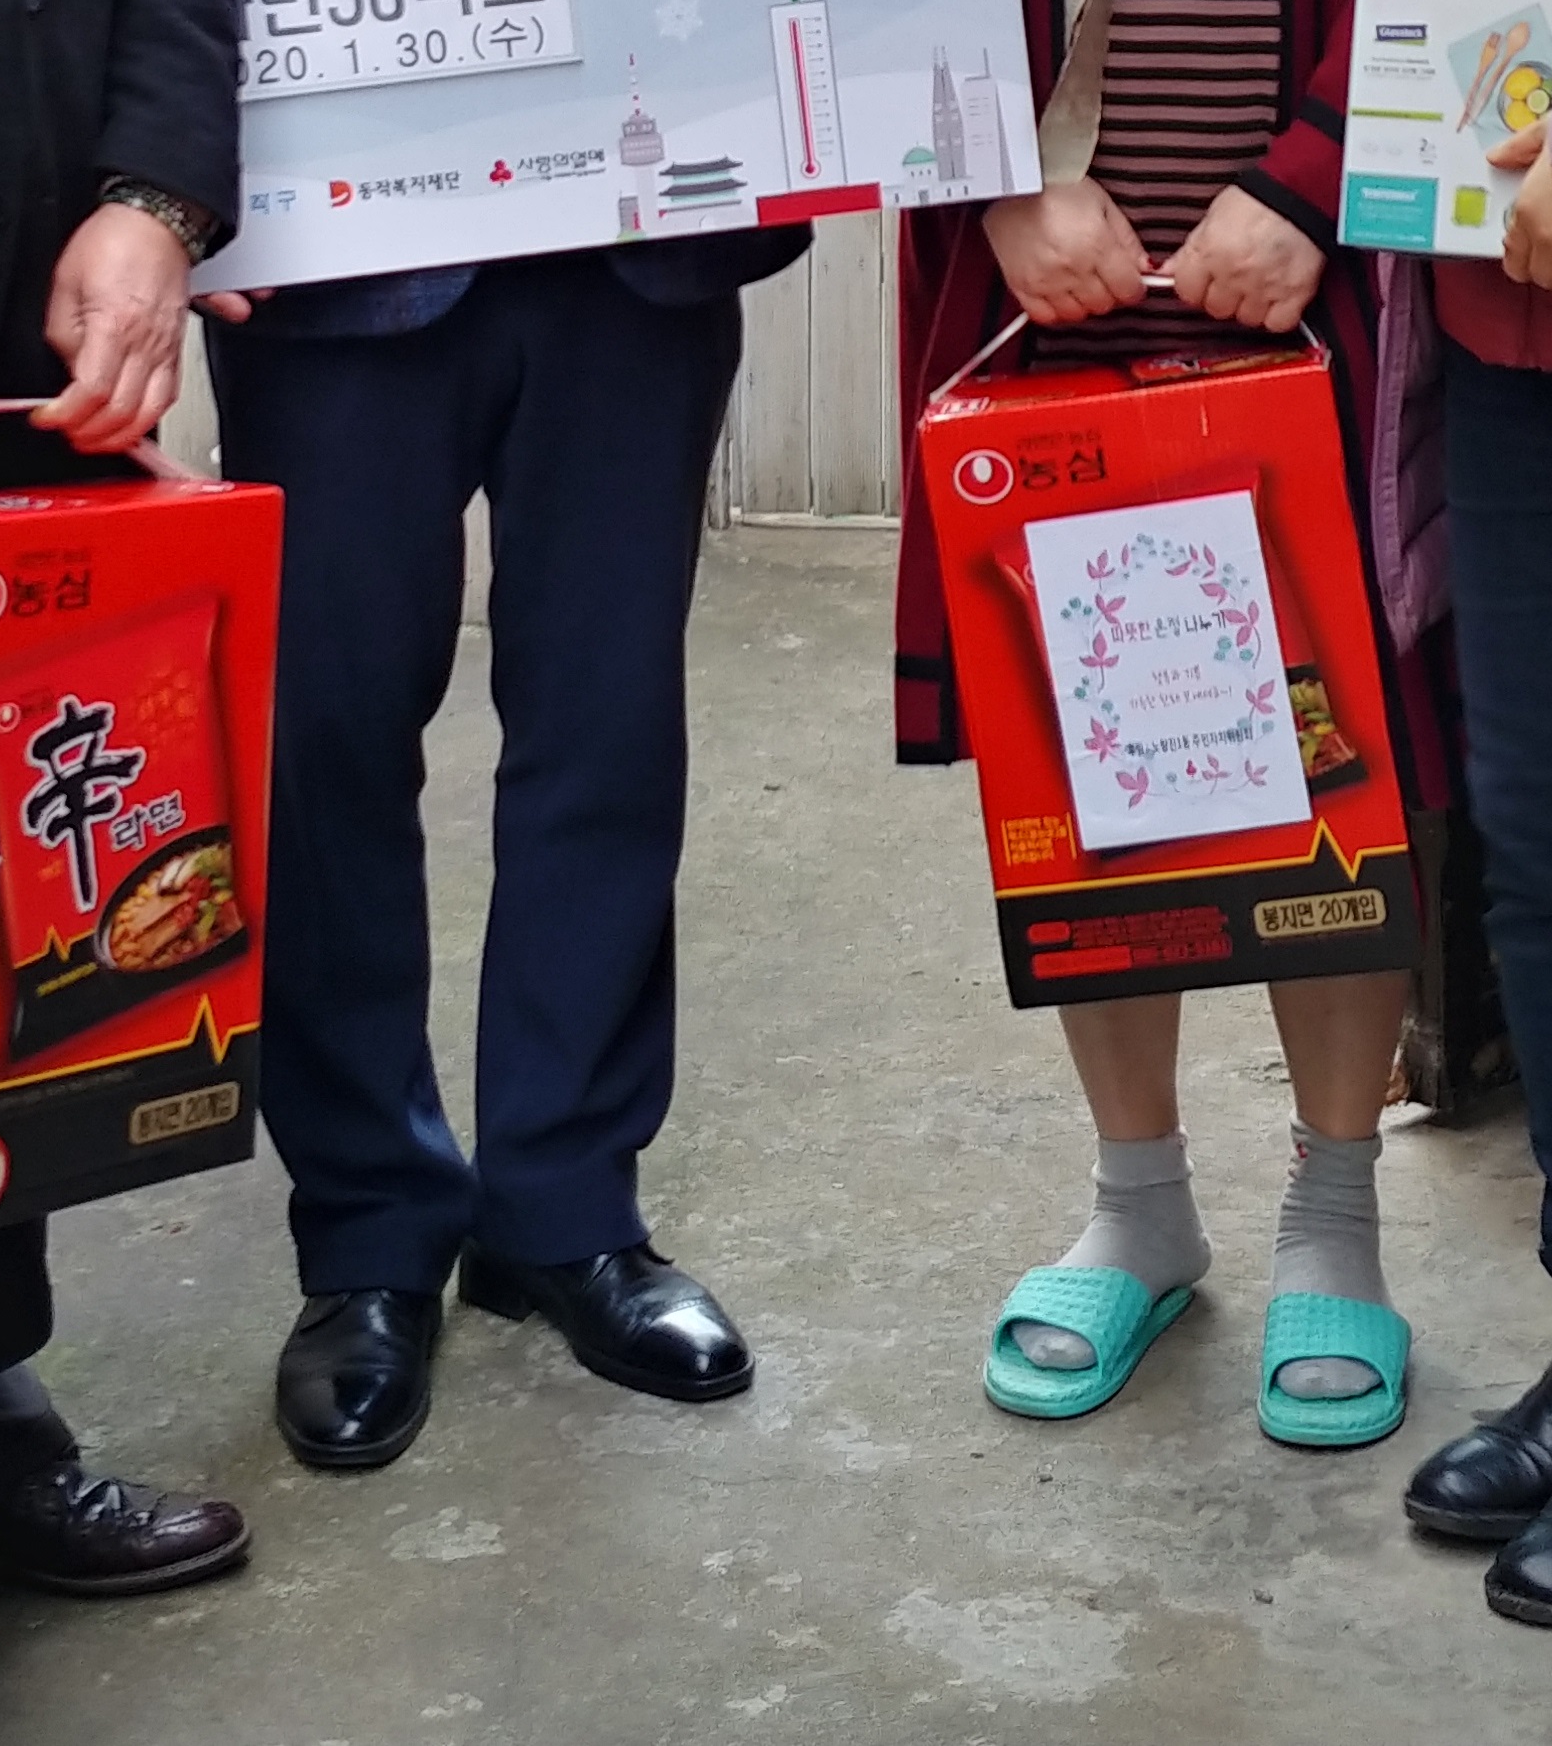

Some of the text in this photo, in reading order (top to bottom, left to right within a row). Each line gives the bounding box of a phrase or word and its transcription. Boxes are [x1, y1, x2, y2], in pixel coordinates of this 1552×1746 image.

[23, 694, 145, 912] 辛
[109, 788, 187, 853] 라면
[1261, 900, 1316, 932] 봉지면
[1318, 894, 1379, 927] 20개입
